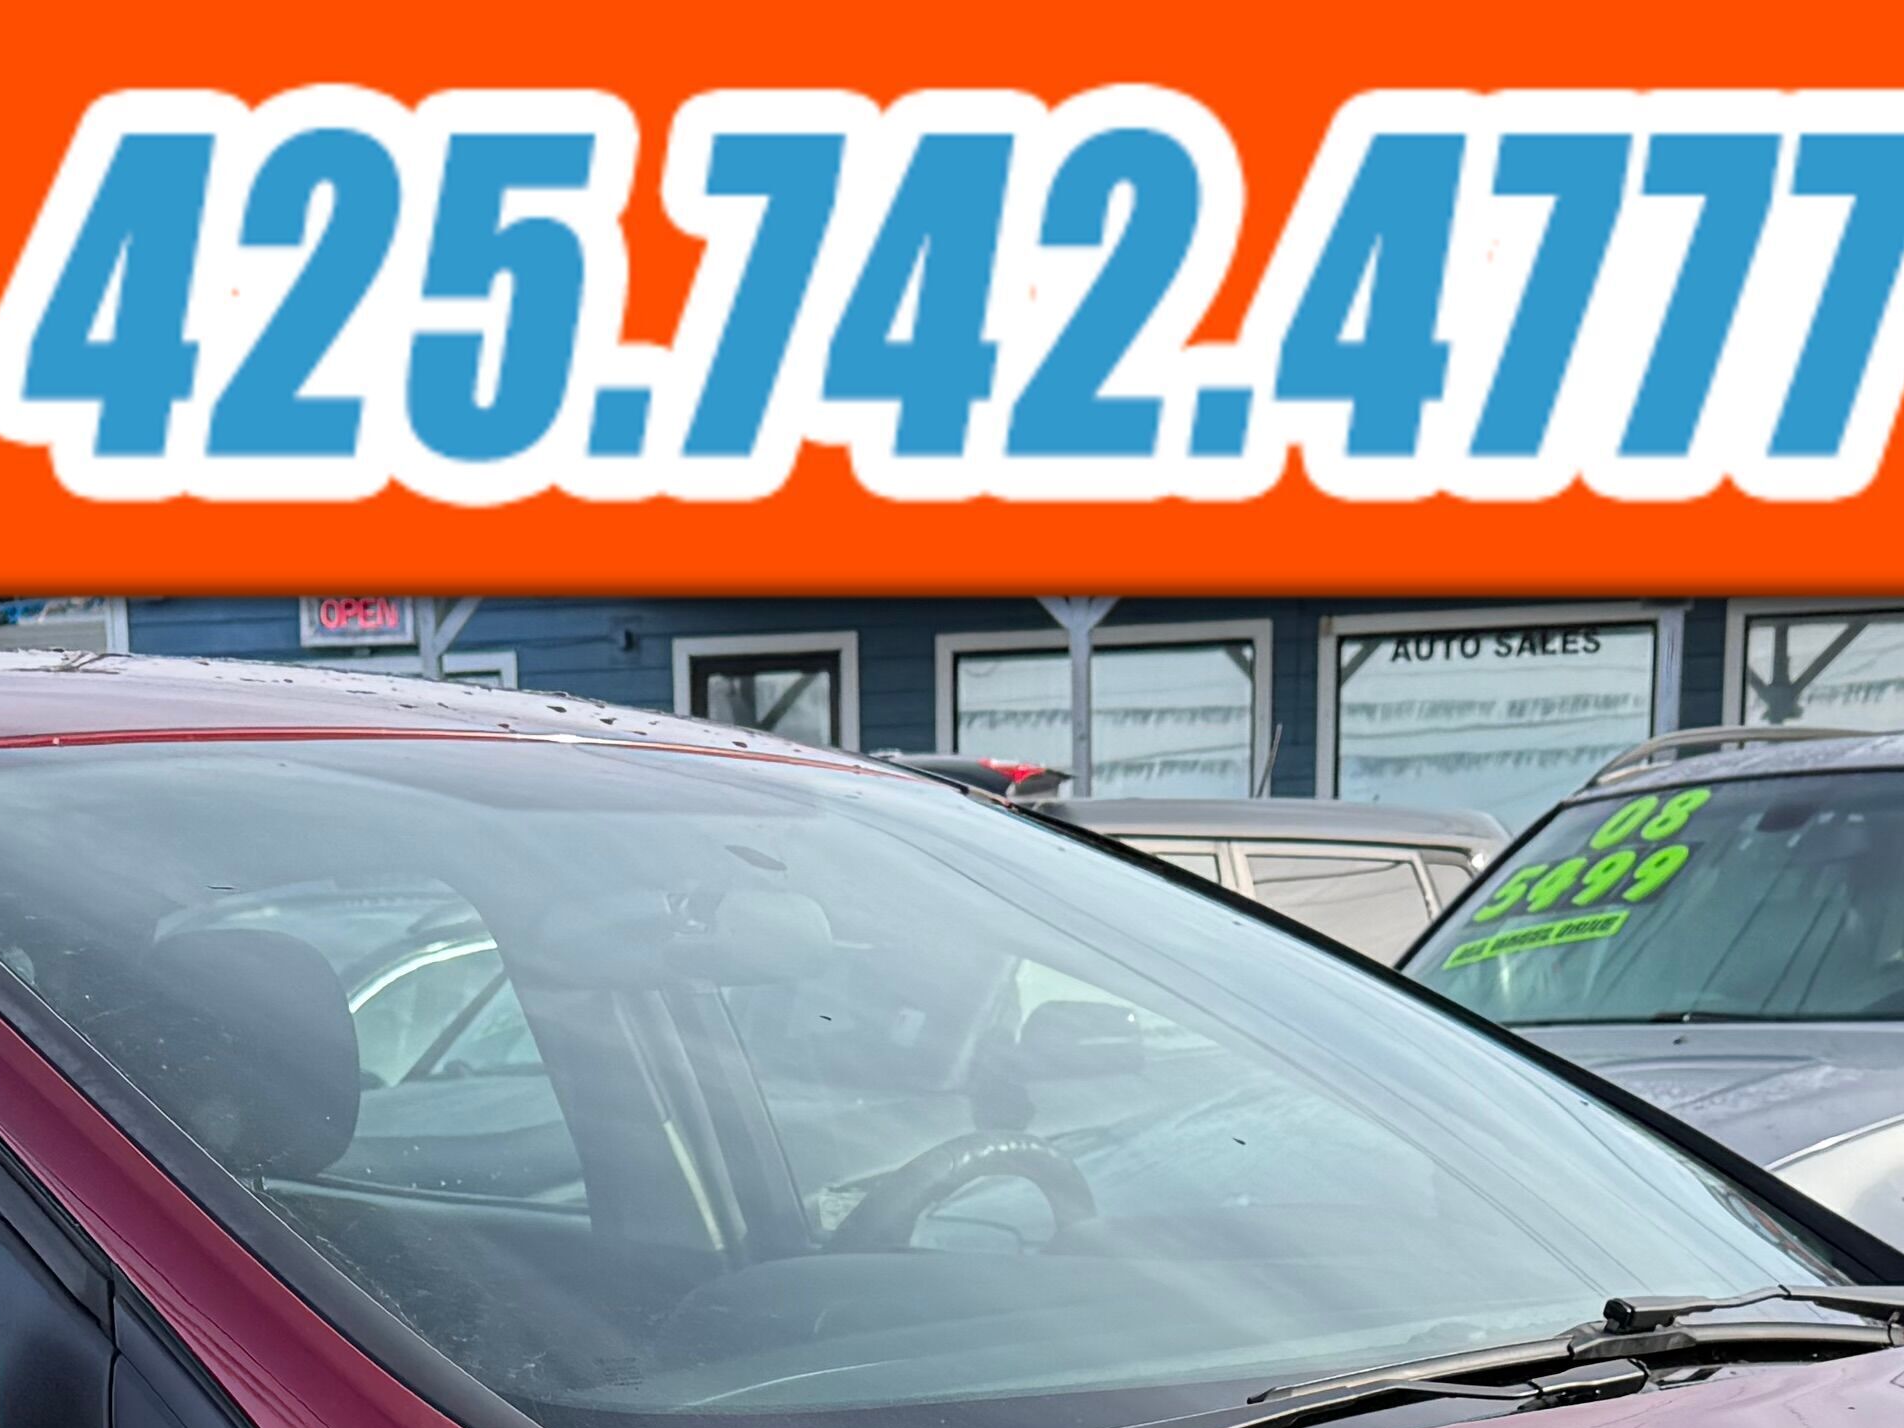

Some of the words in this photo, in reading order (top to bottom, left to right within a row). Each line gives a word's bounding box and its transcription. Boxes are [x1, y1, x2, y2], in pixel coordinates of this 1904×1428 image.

[319, 597, 400, 631] OPEN
[1390, 634, 1482, 662] AUTO
[1494, 627, 1602, 658] SALES
[1590, 786, 1712, 850] 08
[1471, 844, 1690, 922] 5499
